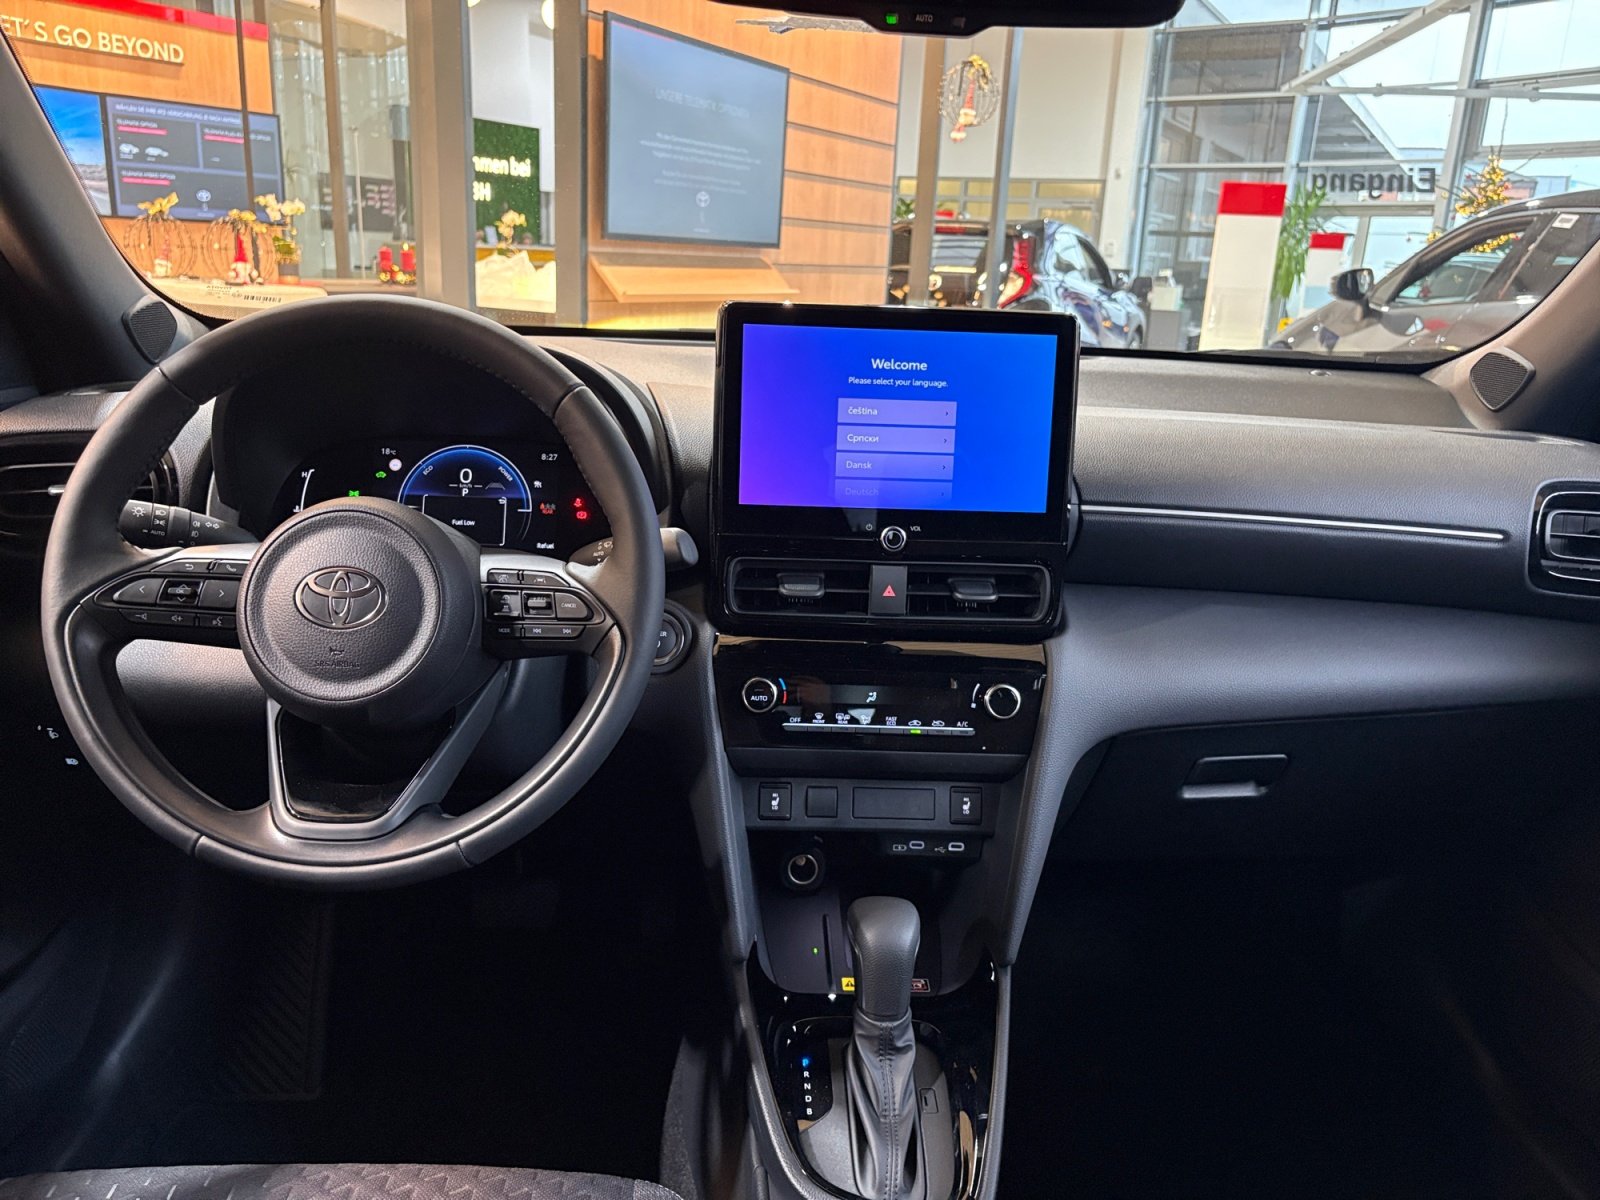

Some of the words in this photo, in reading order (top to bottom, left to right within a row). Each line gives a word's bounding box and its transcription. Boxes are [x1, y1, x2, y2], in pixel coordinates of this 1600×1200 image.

[915, 13, 934, 23] AUTO
[0, 14, 48, 43] ET'S
[53, 24, 92, 49] GO
[97, 31, 185, 64] BEYOND
[509, 155, 532, 178] bei
[870, 357, 928, 371] Welcome
[847, 376, 872, 385] Please
[872, 376, 894, 386] select
[894, 378, 911, 387] your
[912, 378, 948, 389] language.
[846, 433, 879, 444] Српски
[541, 452, 558, 461] 8:27
[422, 464, 434, 476] ECO
[845, 460, 873, 470] Dansk
[459, 467, 473, 484] 0
[462, 488, 469, 497] P
[844, 487, 879, 496] Deutsch
[463, 519, 476, 527] Low
[150, 529, 166, 537] AUTO
[536, 542, 555, 550] Refuel
[805, 1095, 812, 1103] D
